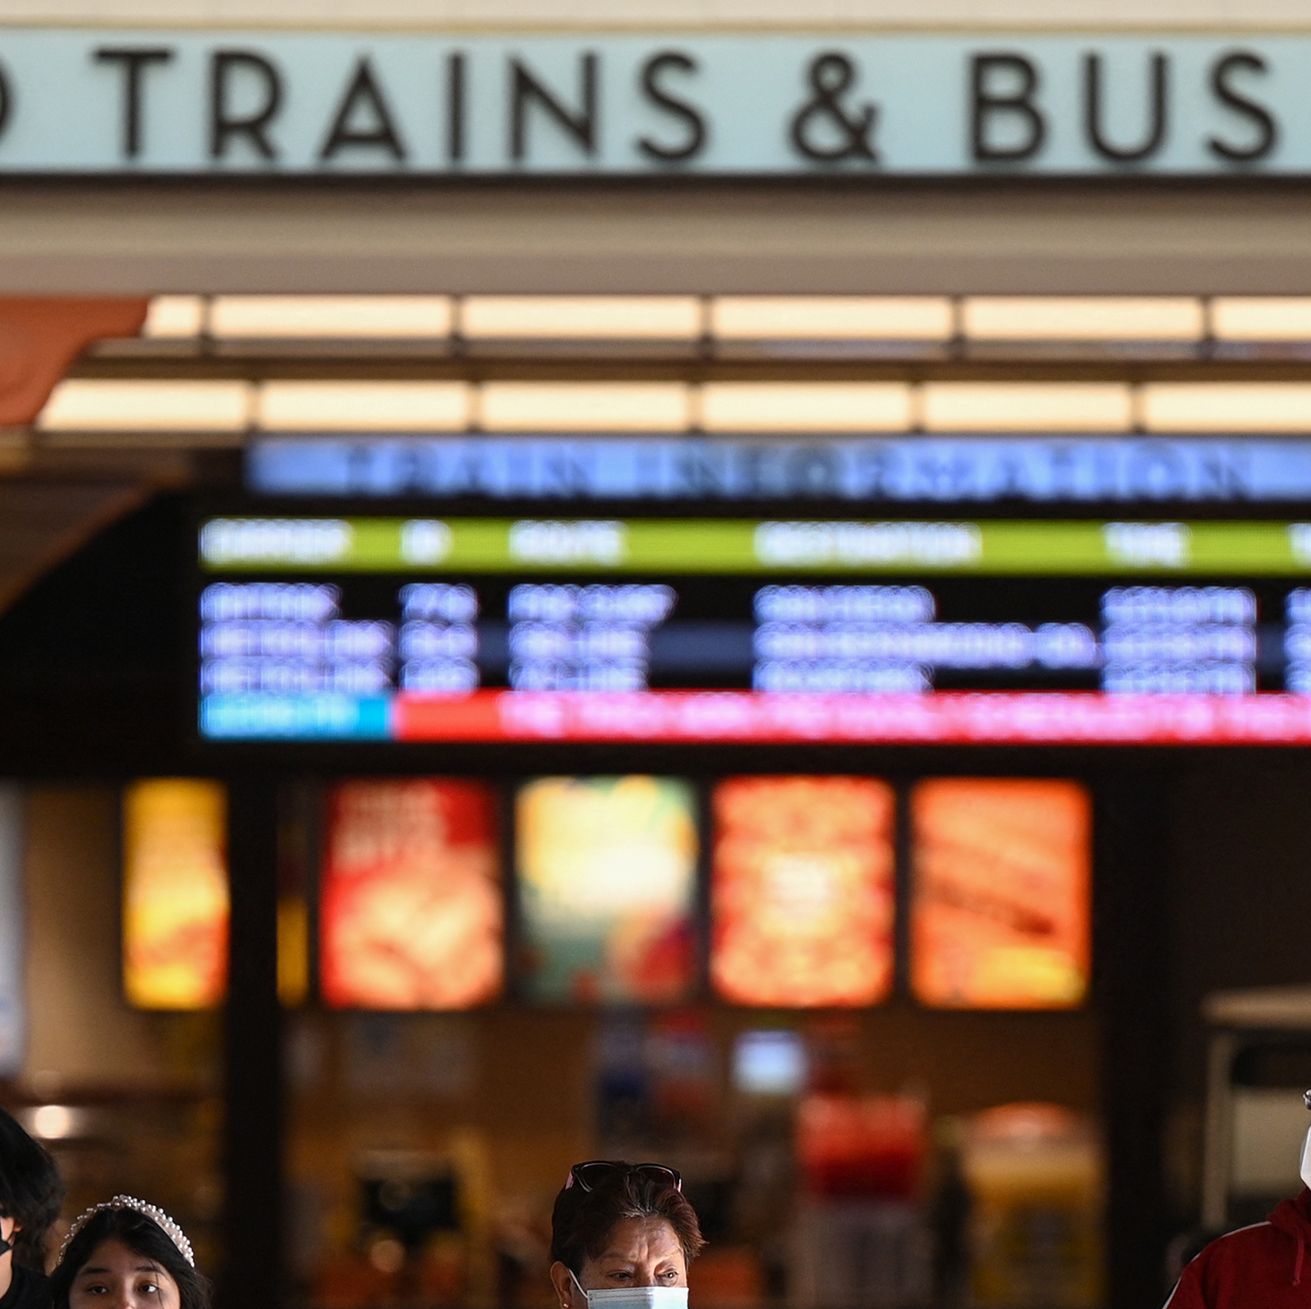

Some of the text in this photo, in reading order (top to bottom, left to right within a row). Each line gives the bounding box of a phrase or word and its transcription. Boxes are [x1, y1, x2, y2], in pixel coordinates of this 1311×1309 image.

[93, 48, 709, 165] TRAINS
[789, 52, 883, 165] &
[969, 51, 1278, 165] BUS
